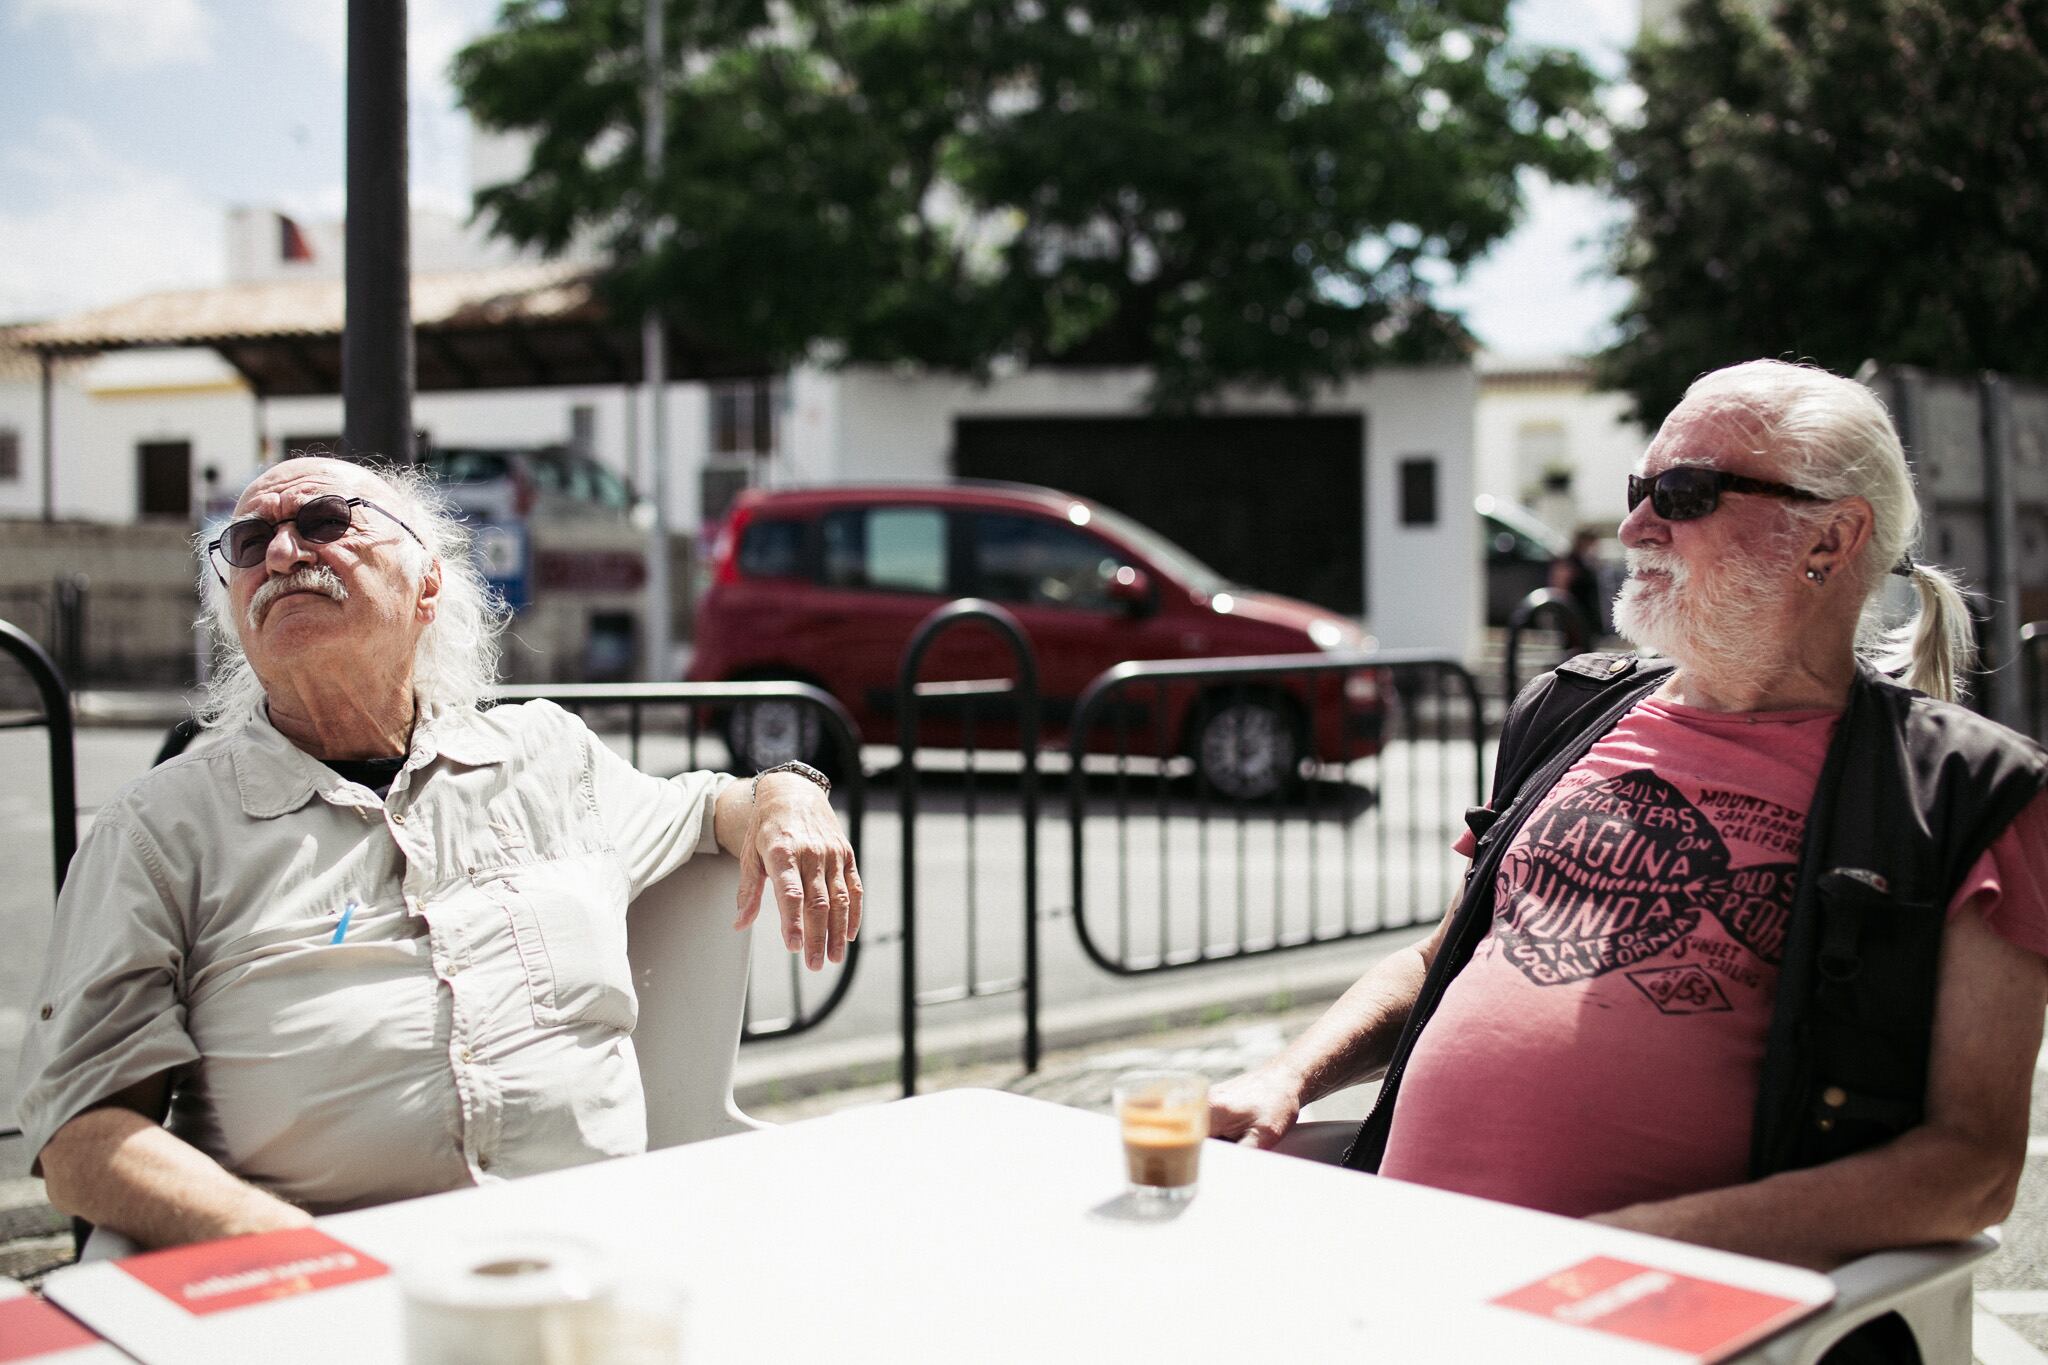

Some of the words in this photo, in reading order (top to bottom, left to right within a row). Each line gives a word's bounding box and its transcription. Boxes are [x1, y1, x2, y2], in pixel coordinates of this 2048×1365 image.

[1595, 778, 1668, 803] DAILY
[1560, 790, 1698, 833] CHARTERS
[1538, 814, 1690, 879] LAGUNA
[1676, 835, 1711, 850] ON
[1721, 824, 1801, 856] CALIFOR
[1731, 871, 1777, 895] OLD
[1512, 937, 1613, 966] STATE
[1618, 928, 1649, 947] OF
[1531, 918, 1694, 985] CALIFORNIA
